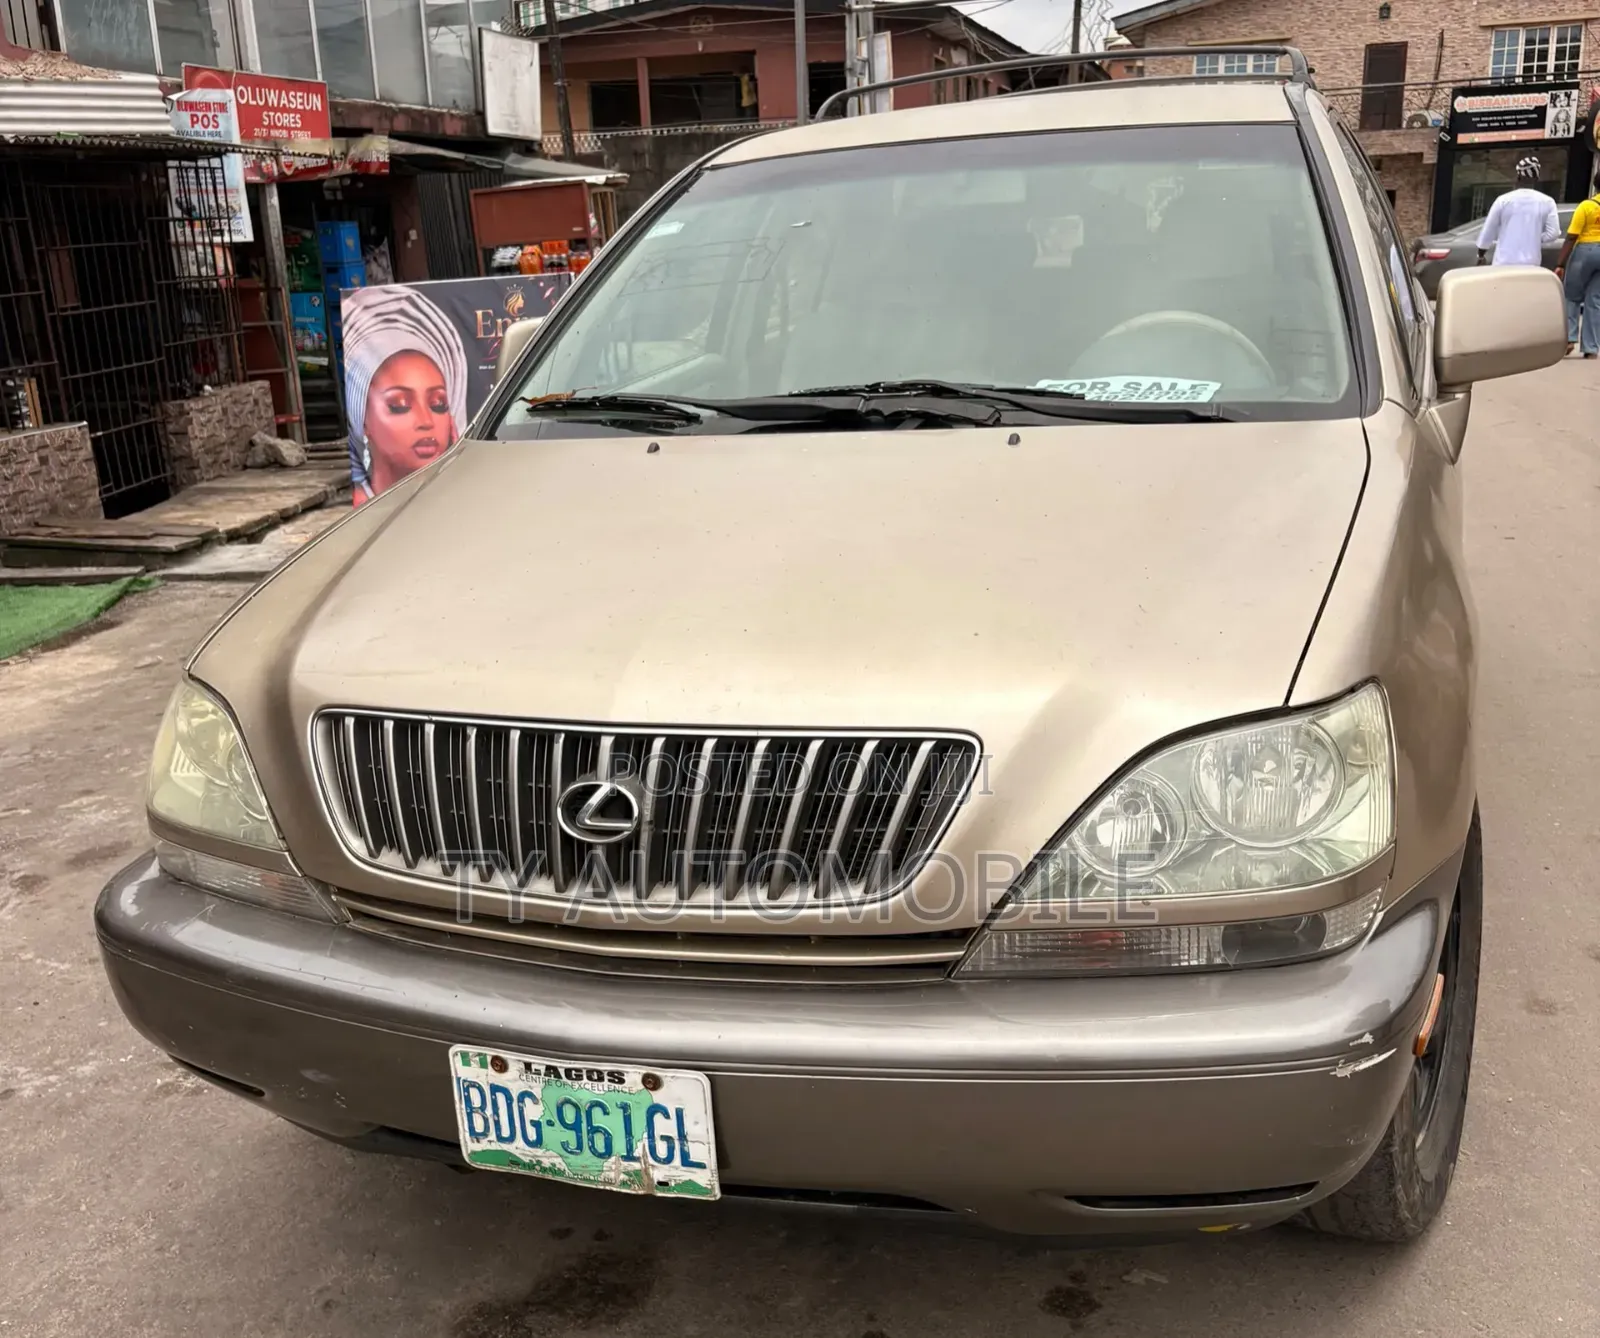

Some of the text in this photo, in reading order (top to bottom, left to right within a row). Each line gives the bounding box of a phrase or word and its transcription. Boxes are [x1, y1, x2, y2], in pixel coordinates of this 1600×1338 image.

[236, 85, 322, 112] OLUWASEUN
[190, 113, 219, 129] POS
[262, 111, 302, 128] STORES
[1120, 381, 1211, 392] SALE
[523, 1062, 626, 1085] LAGOS
[519, 1073, 635, 1096] CENTRE OF EXCELLENCE
